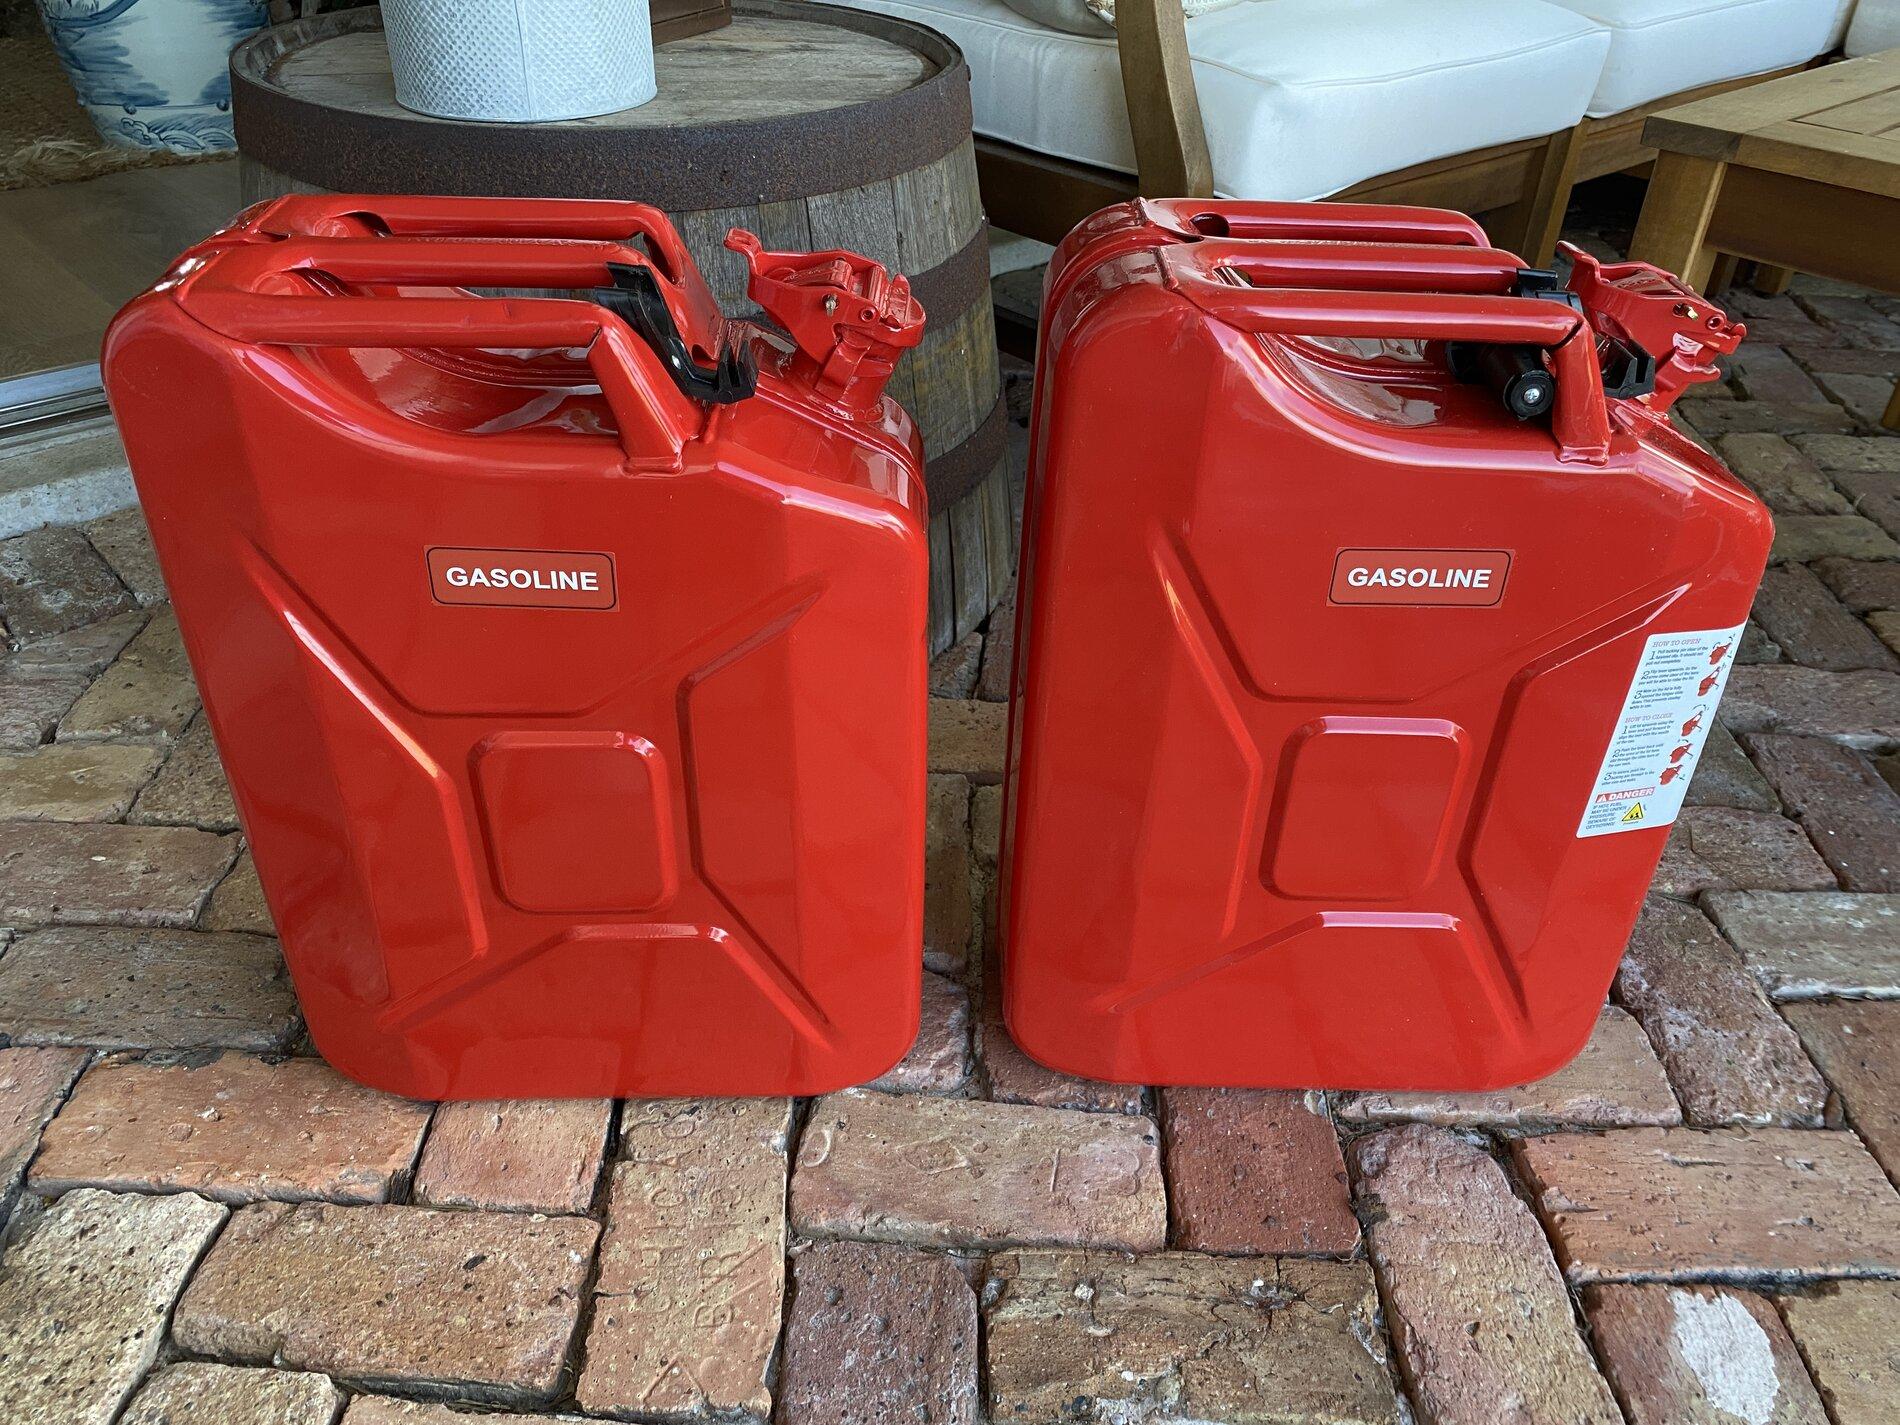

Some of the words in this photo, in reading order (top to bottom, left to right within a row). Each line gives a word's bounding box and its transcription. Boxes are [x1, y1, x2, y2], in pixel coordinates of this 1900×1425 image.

[446, 567, 599, 591] GASOLINE
[1347, 567, 1492, 588] GASOLINE
[1652, 640, 1670, 648] HOW
[1609, 788, 1655, 801] DANGER
